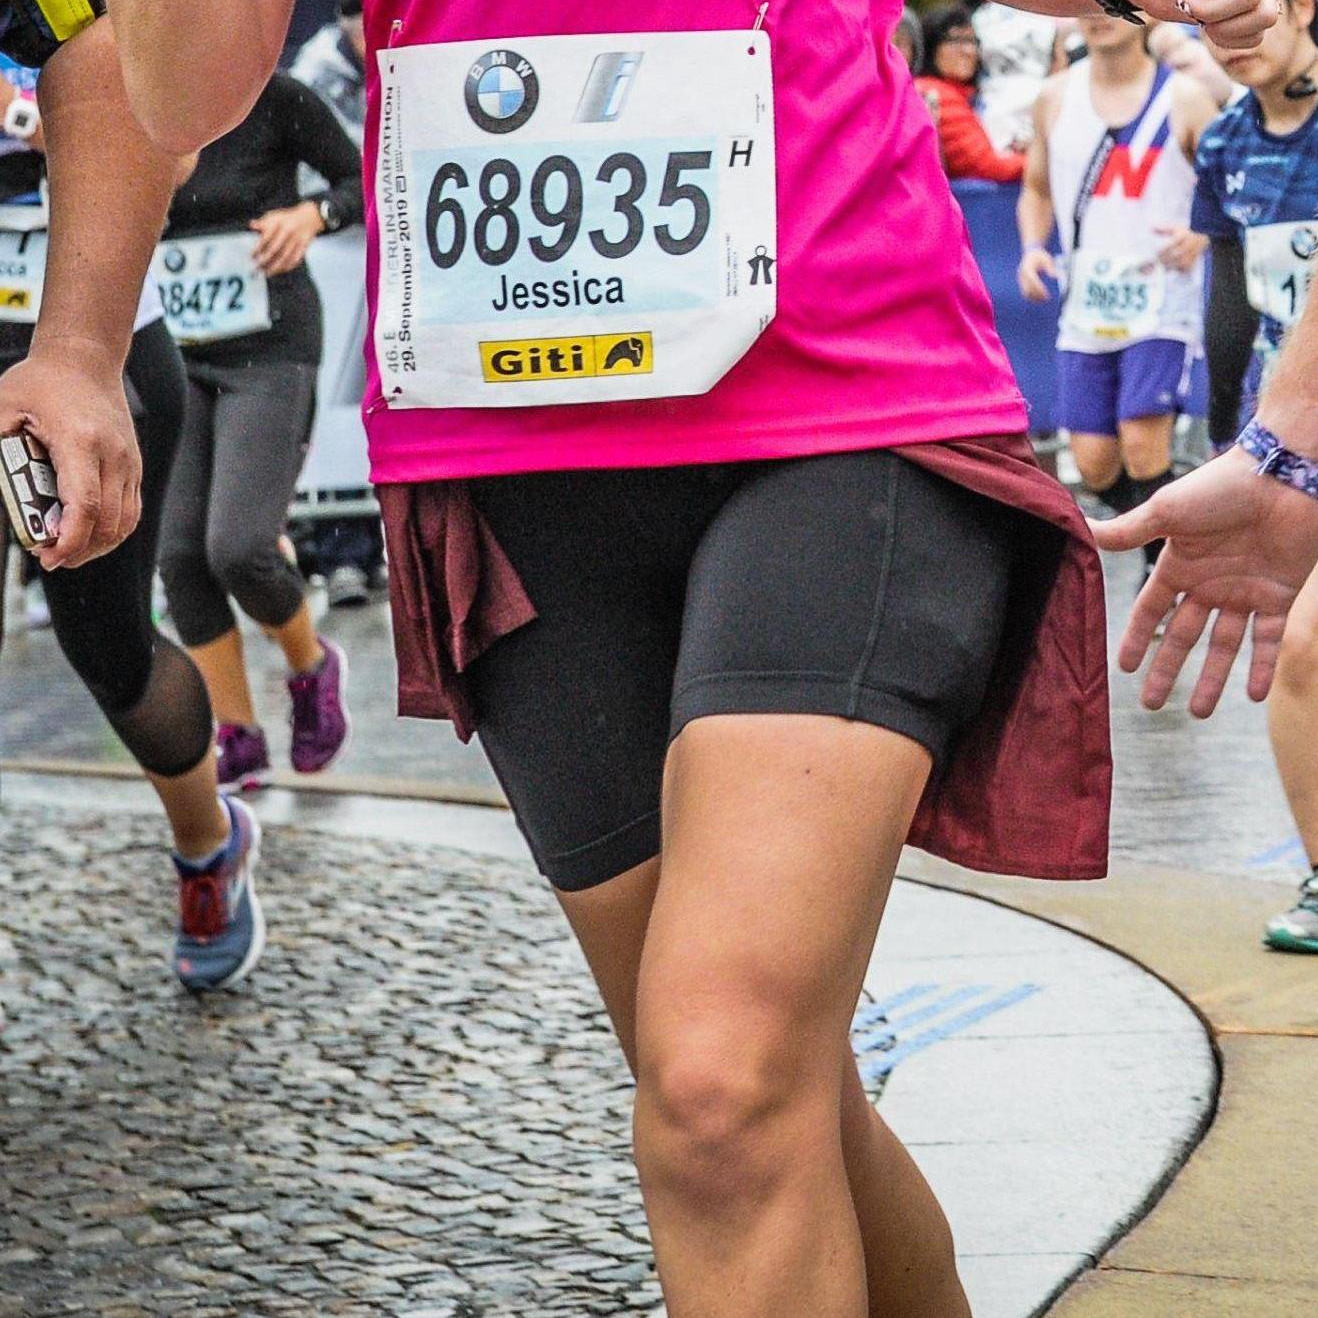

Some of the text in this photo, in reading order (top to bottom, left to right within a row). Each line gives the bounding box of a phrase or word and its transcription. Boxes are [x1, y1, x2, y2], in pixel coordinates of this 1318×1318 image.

[469, 51, 533, 80] BMW
[425, 150, 714, 270] 68935
[729, 140, 754, 168] H
[396, 199, 416, 373] 29. September 2019
[491, 269, 625, 312] Jessica
[490, 344, 584, 376] Giti
